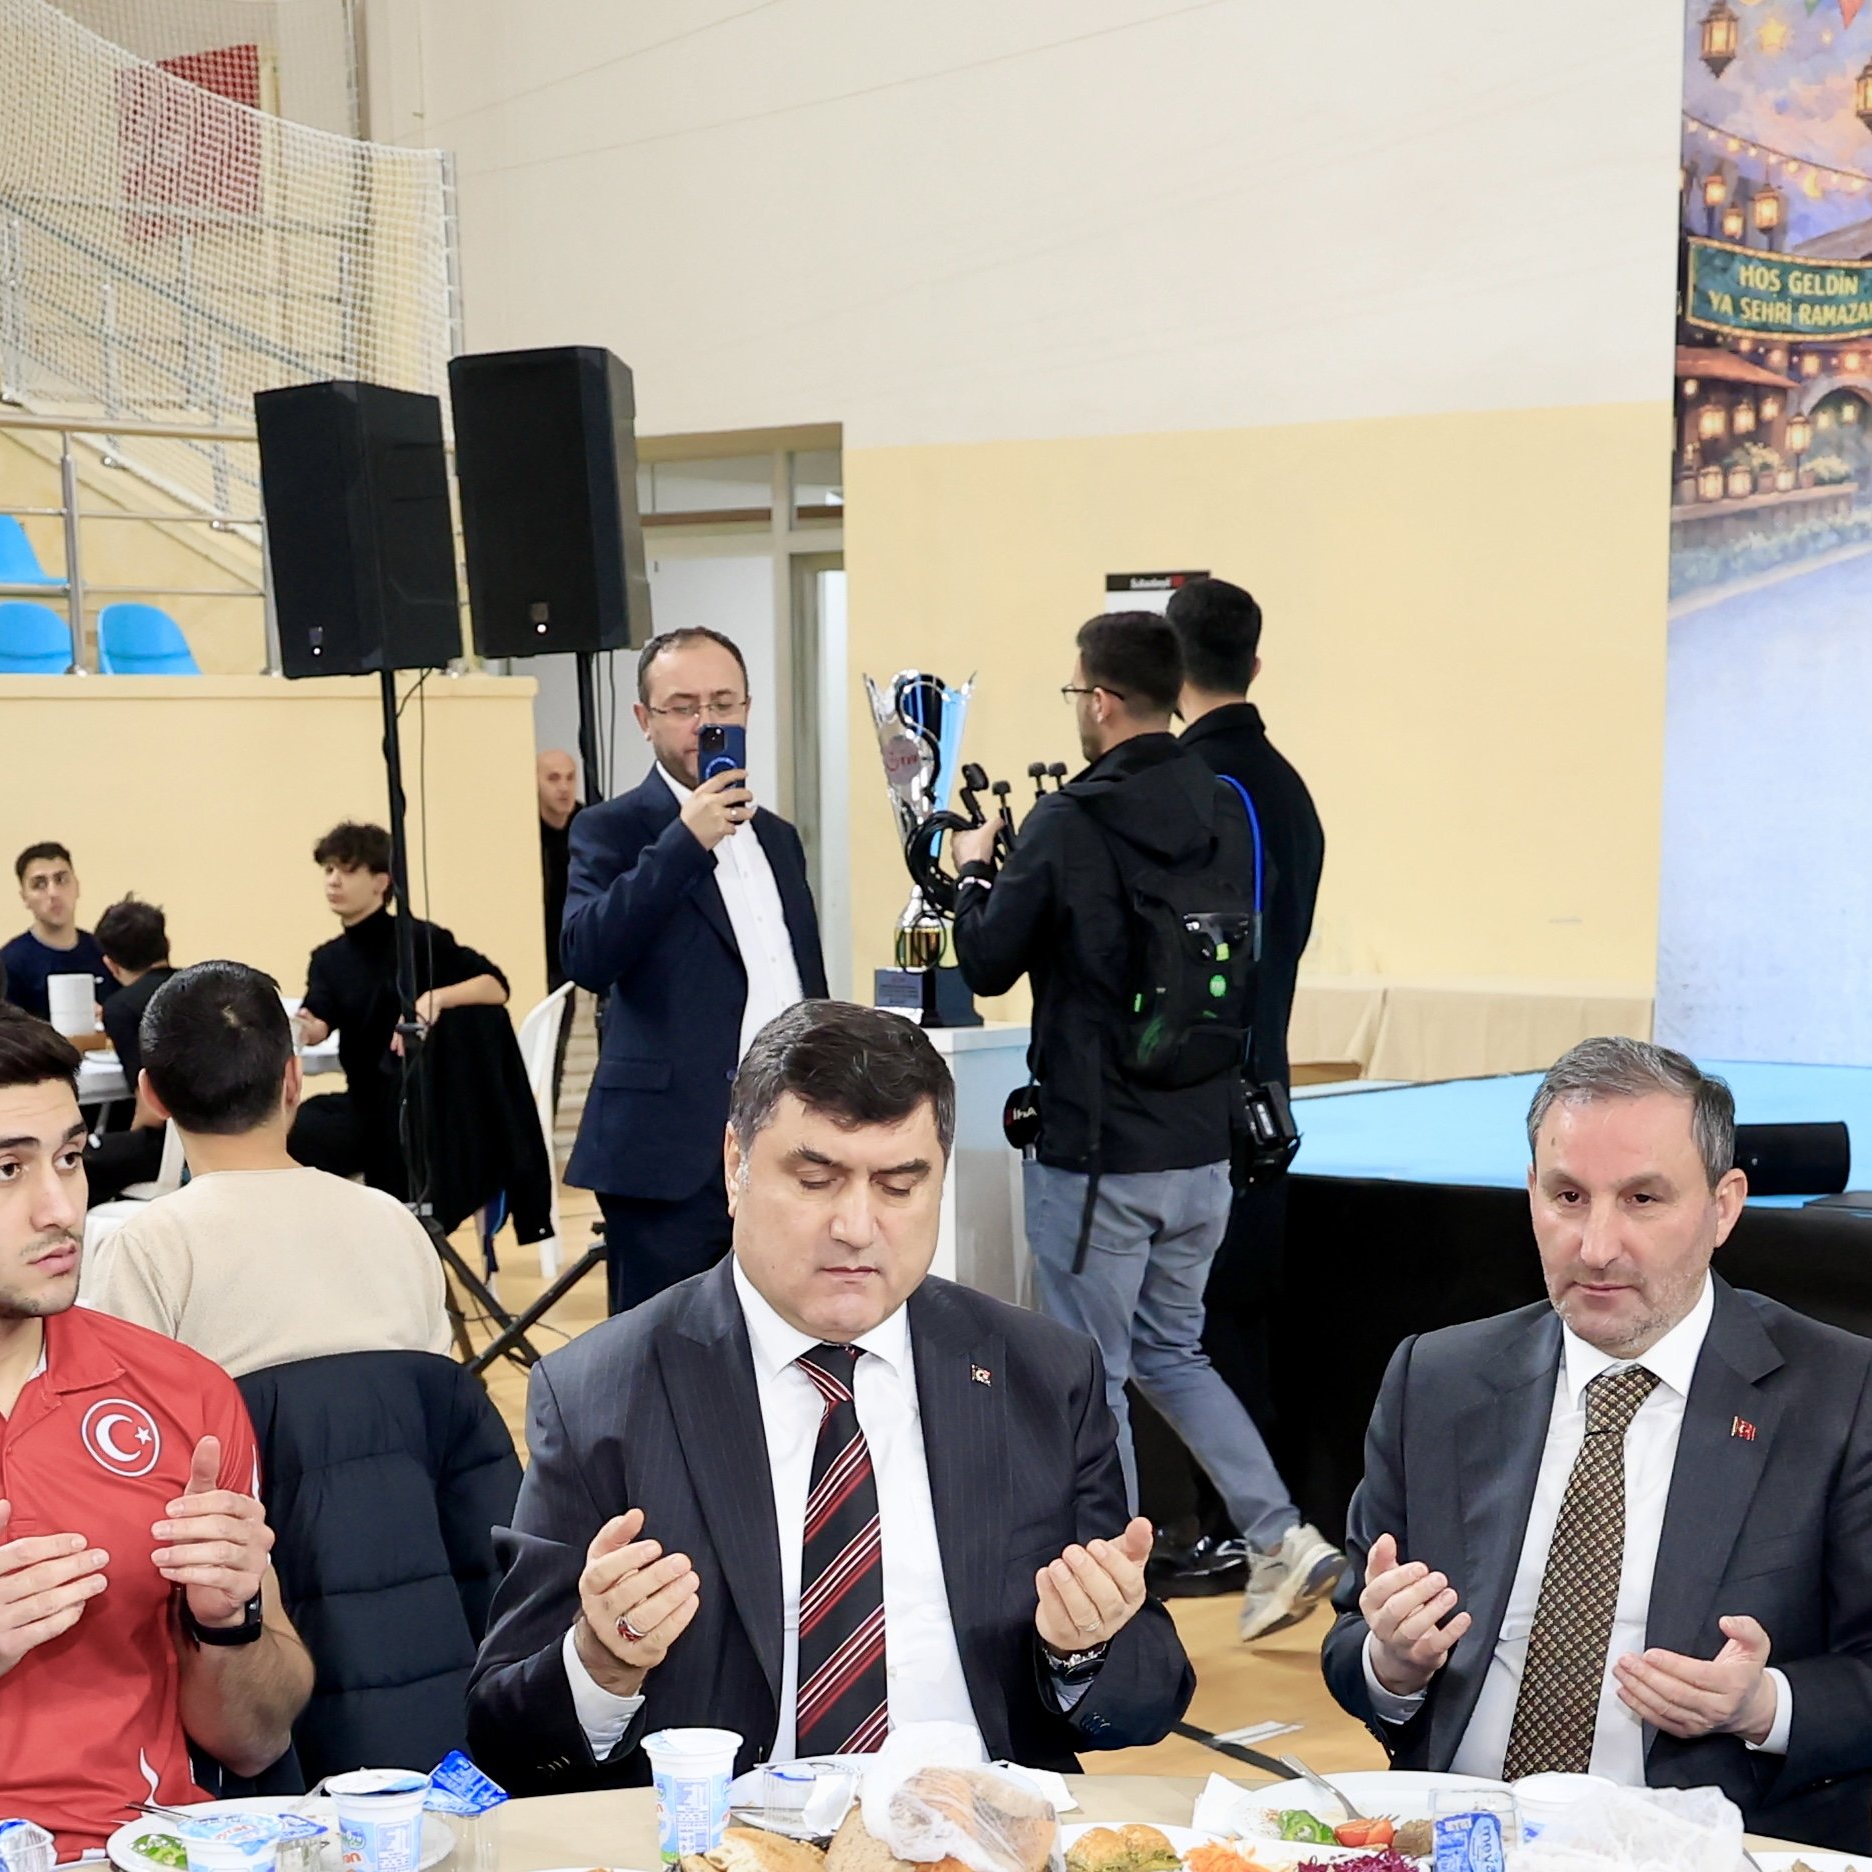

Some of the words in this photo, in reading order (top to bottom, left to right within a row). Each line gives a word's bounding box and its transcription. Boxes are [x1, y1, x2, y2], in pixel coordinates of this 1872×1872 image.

[1739, 264, 1782, 298] HOŞ
[1787, 269, 1859, 297] GELDİN
[1708, 289, 1733, 315] YA
[1740, 296, 1793, 327] ŞEHRİ
